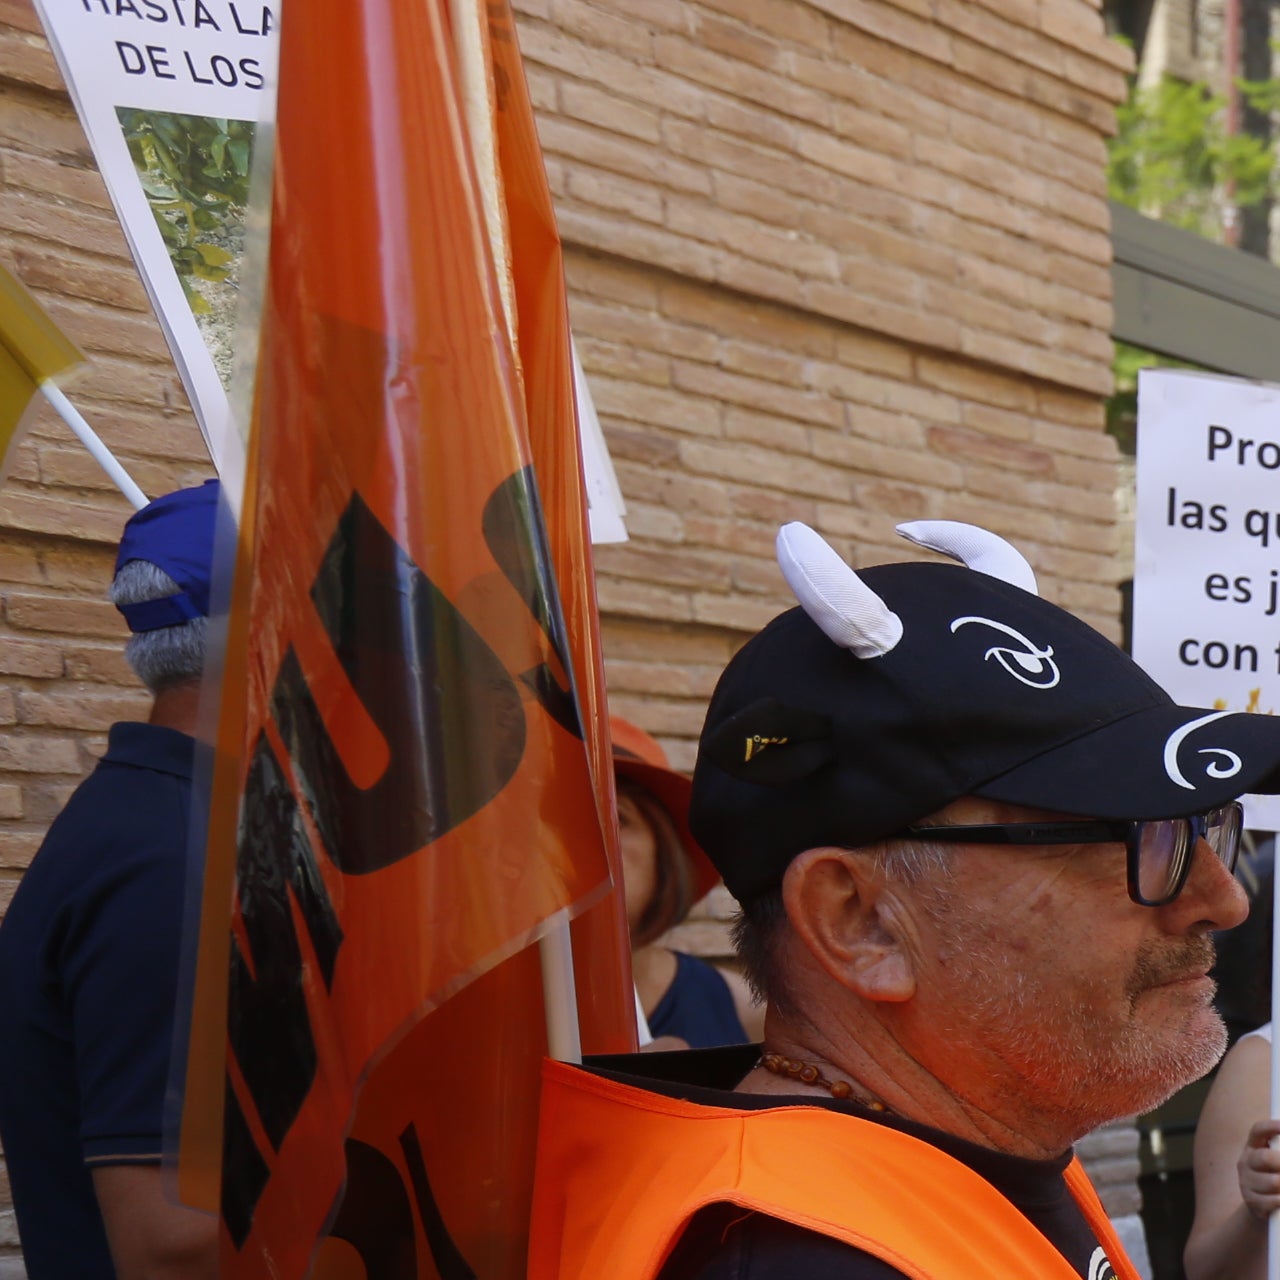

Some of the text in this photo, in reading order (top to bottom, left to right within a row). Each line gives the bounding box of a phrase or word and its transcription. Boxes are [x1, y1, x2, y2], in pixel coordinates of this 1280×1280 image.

[116, 41, 264, 90] DE LOS
[1167, 487, 1228, 533] las
[1205, 573, 1252, 604] es
[1179, 639, 1258, 673] con
